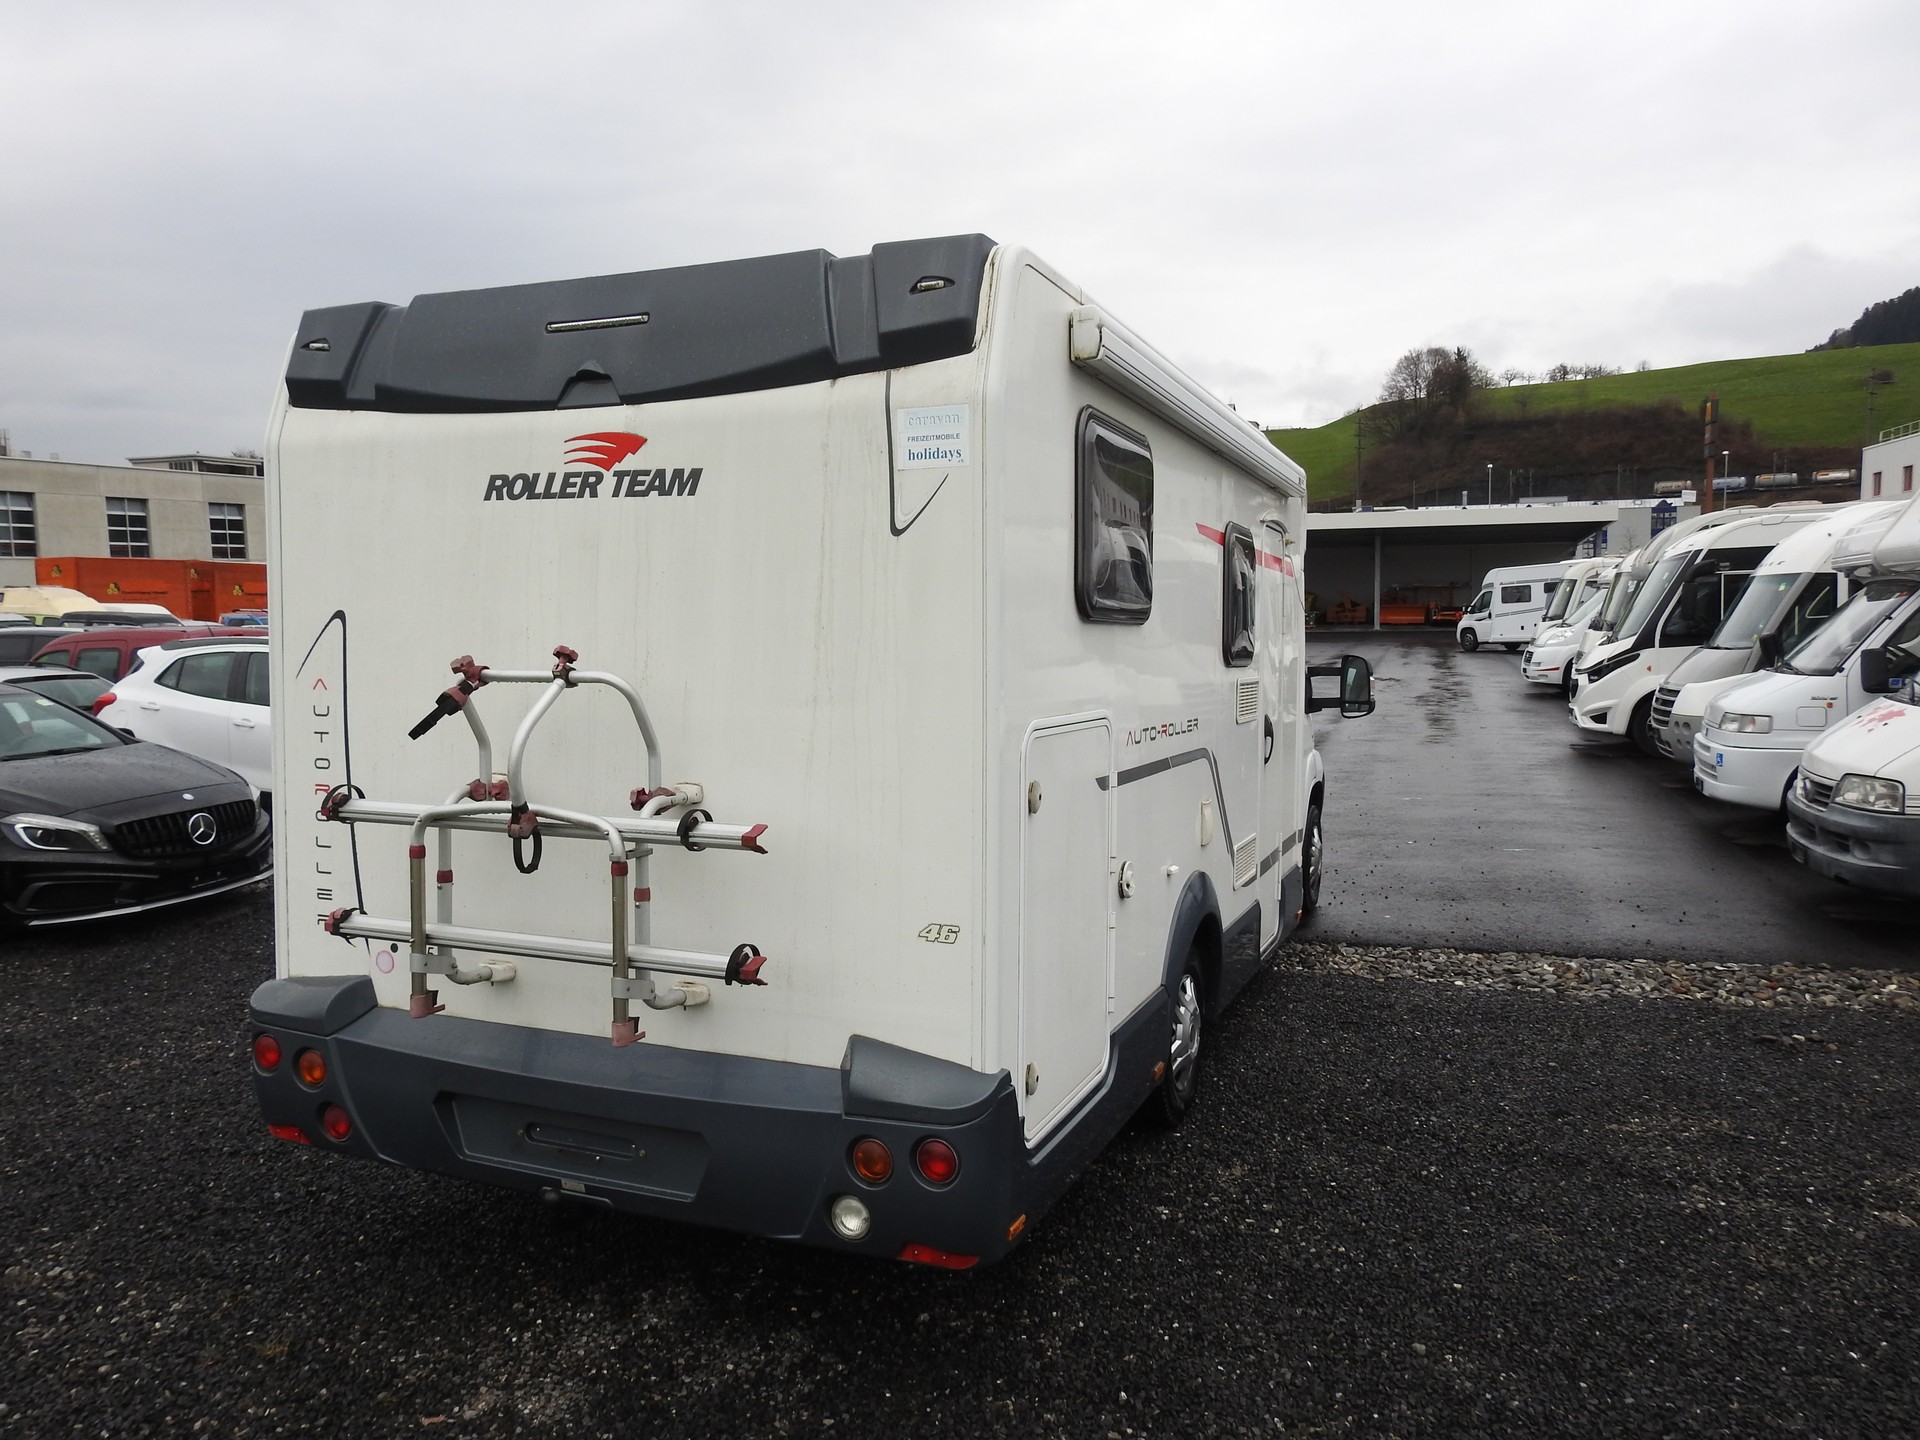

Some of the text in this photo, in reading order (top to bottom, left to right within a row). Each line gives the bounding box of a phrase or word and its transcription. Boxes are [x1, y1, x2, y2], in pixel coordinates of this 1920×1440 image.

[907, 432, 961, 443] FREIZEITMOBILE
[908, 447, 962, 462] holidays
[483, 467, 704, 501] ROLLER TEAM
[1126, 718, 1199, 747] AUTO-ROLLER
[917, 923, 961, 945] 46
